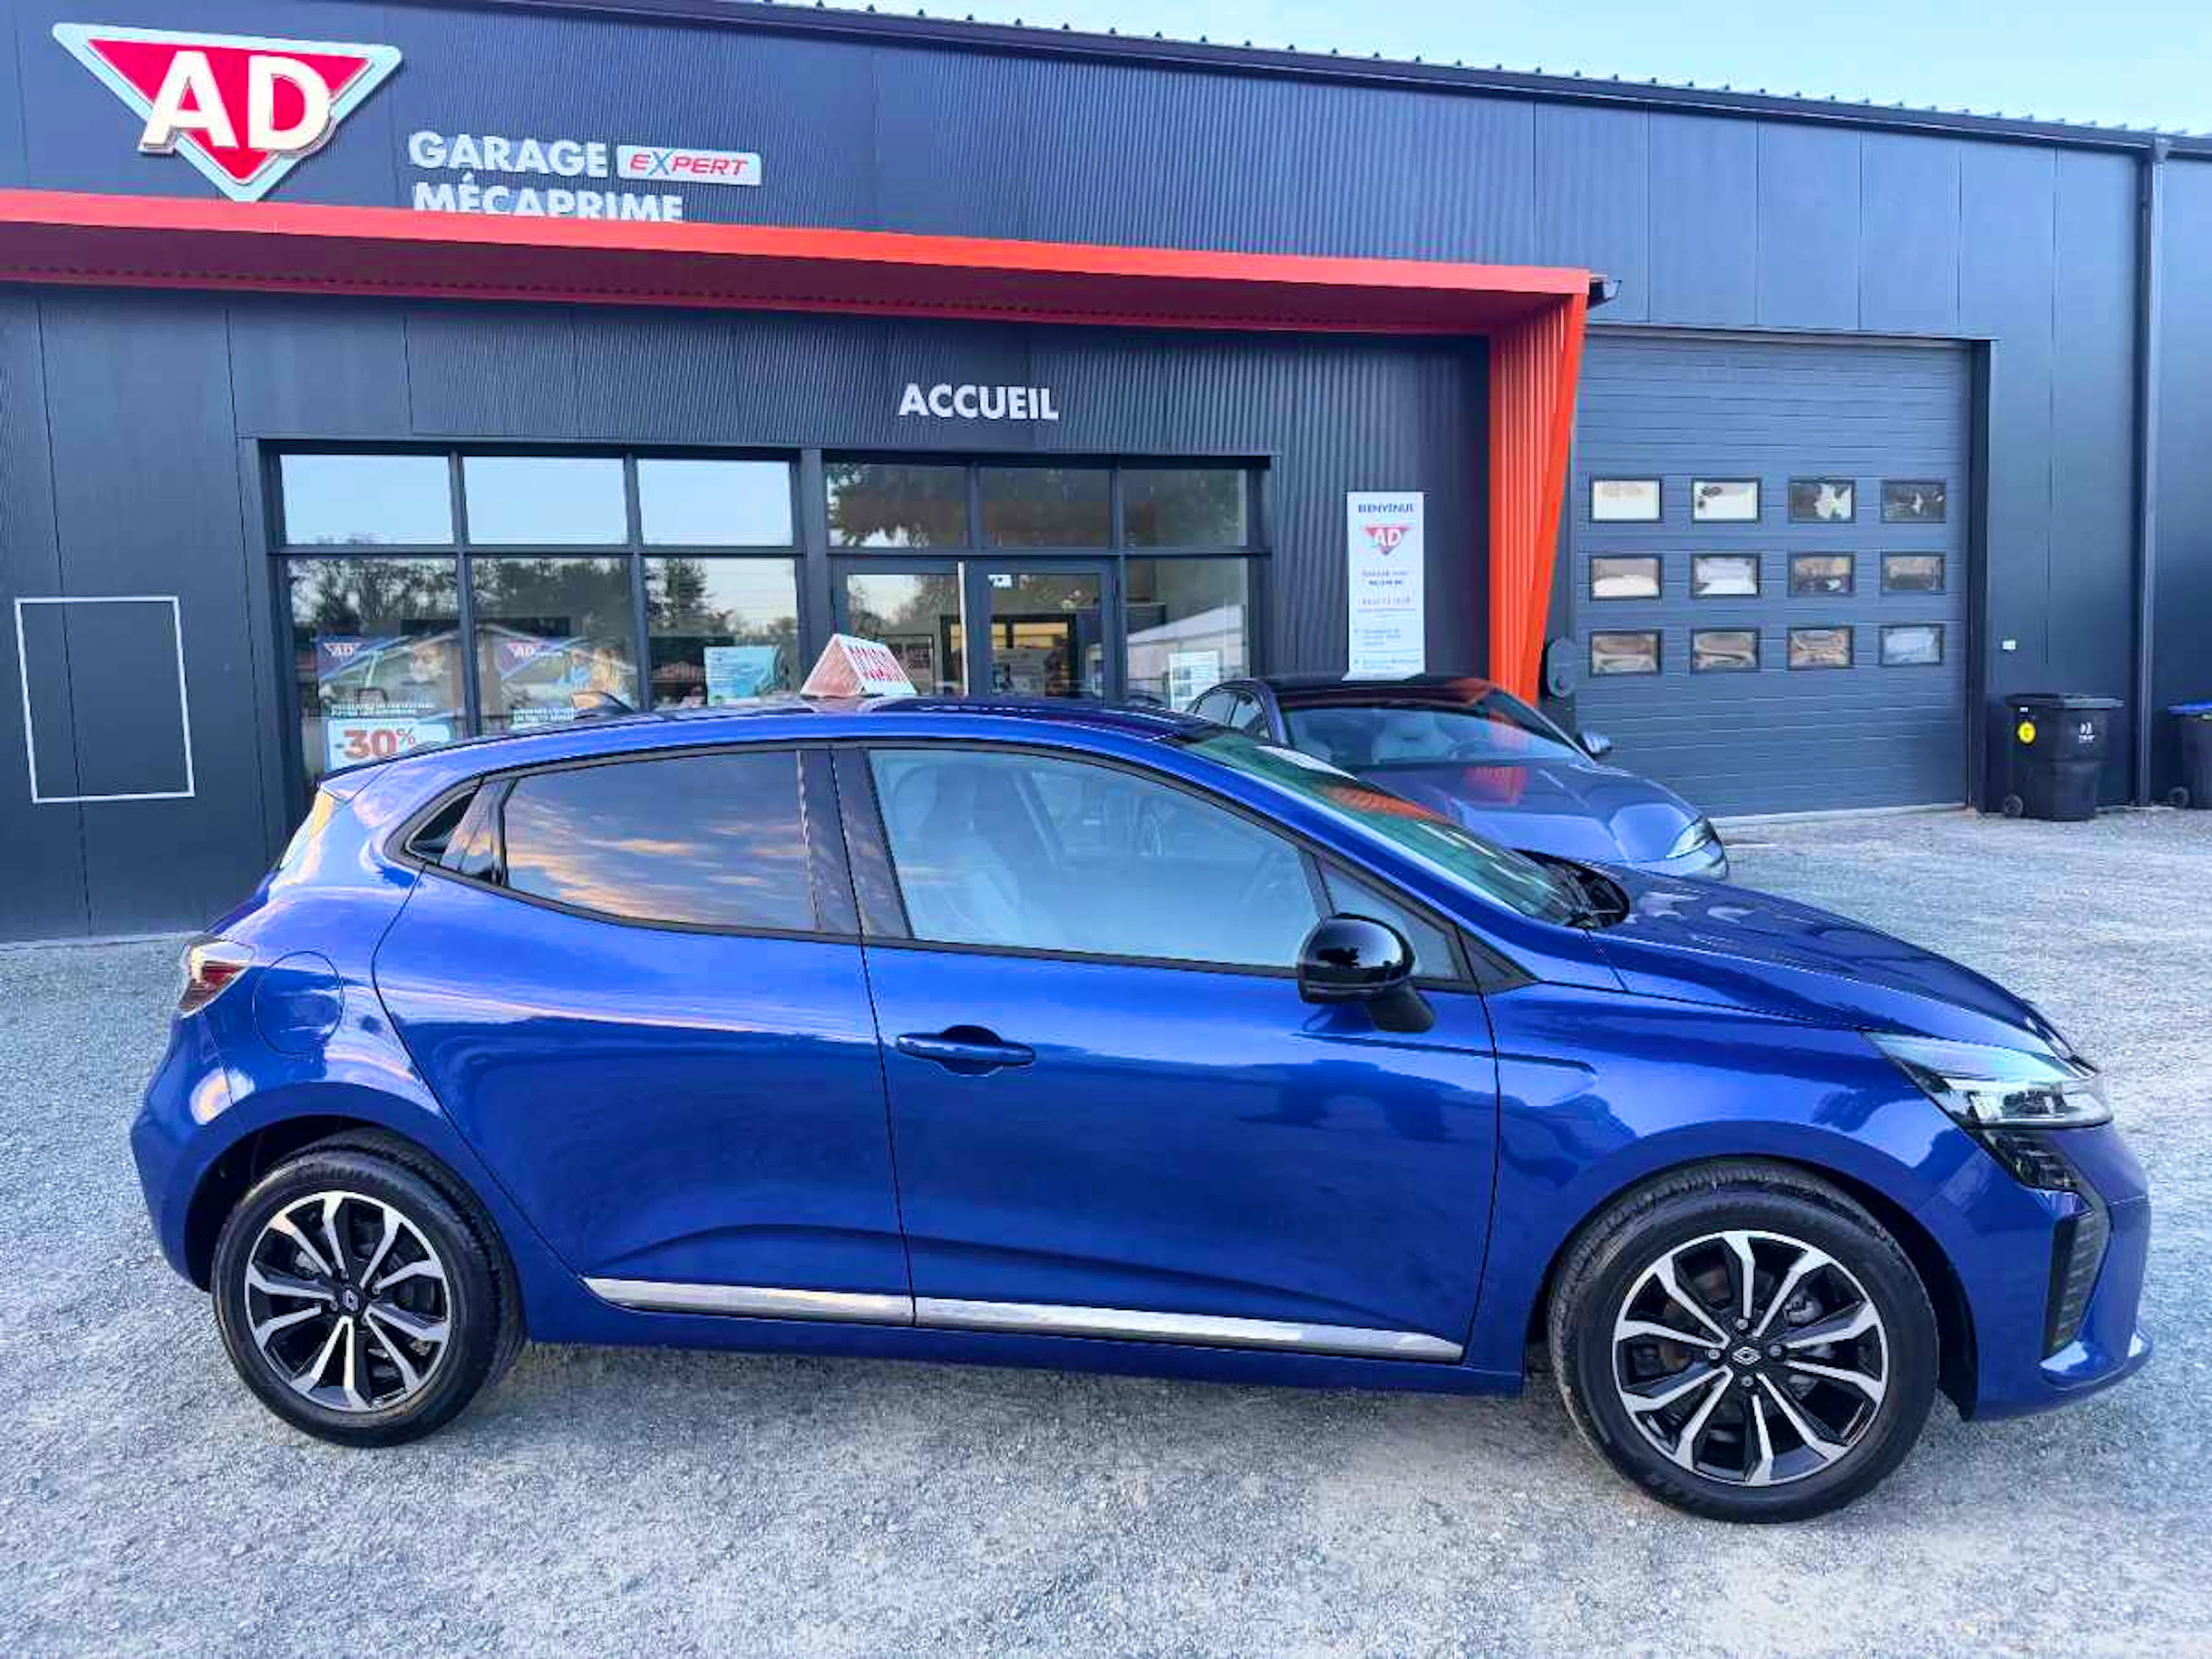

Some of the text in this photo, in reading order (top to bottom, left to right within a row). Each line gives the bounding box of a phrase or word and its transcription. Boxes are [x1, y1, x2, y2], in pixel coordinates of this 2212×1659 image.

[140, 51, 332, 152] AD
[408, 130, 748, 177] GARAGE EXPERT
[413, 172, 683, 221] MÉCAPRIME
[899, 382, 1059, 420] ACCUEIL
[1373, 528, 1402, 547] AD
